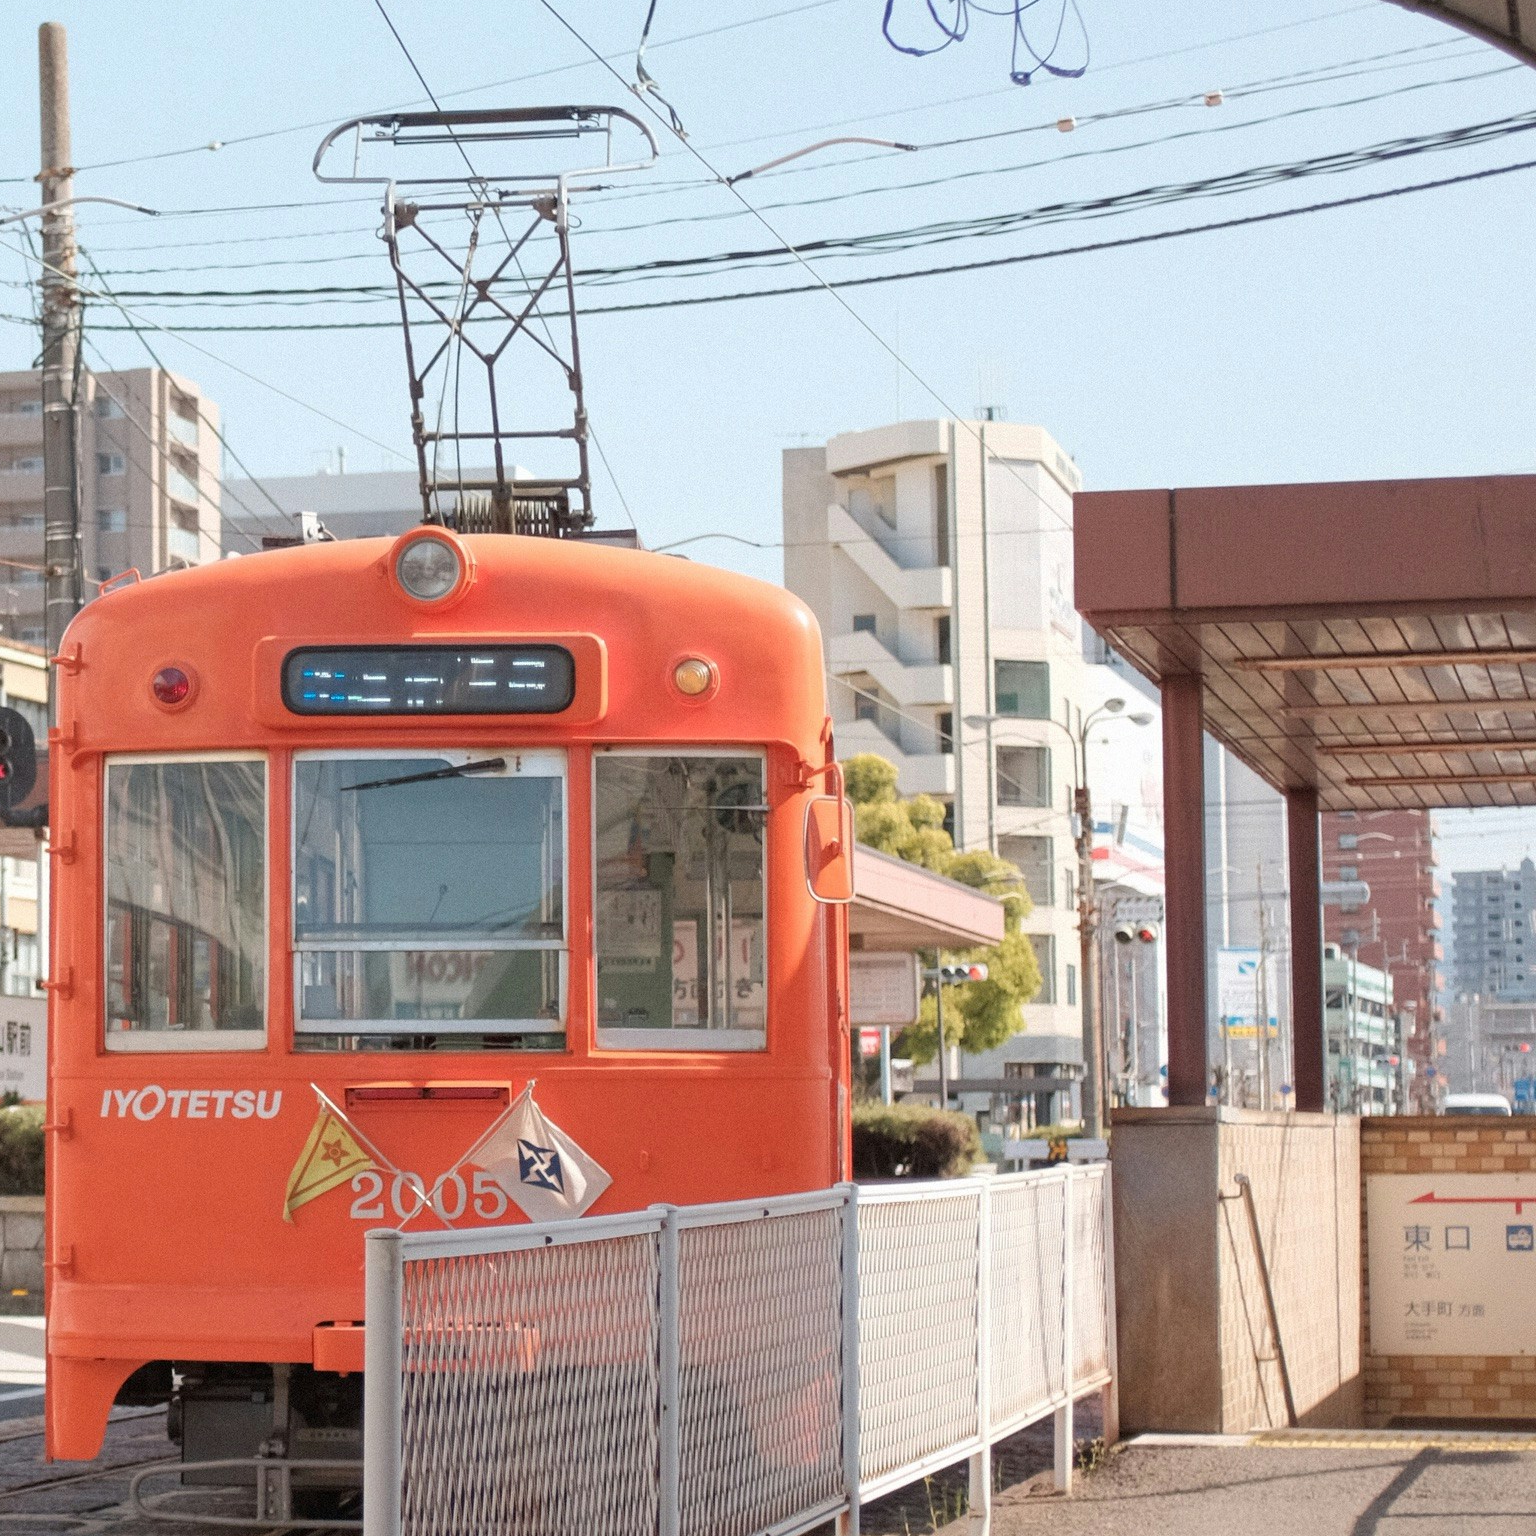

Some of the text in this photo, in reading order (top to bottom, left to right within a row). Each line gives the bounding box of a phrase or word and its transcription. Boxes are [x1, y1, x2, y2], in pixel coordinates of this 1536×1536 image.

[100, 1084, 282, 1121] IYOTETSU
[350, 1171, 508, 1220] 2005
[1403, 1224, 1470, 1251] 東口
[1405, 1301, 1453, 1316] 大手町
